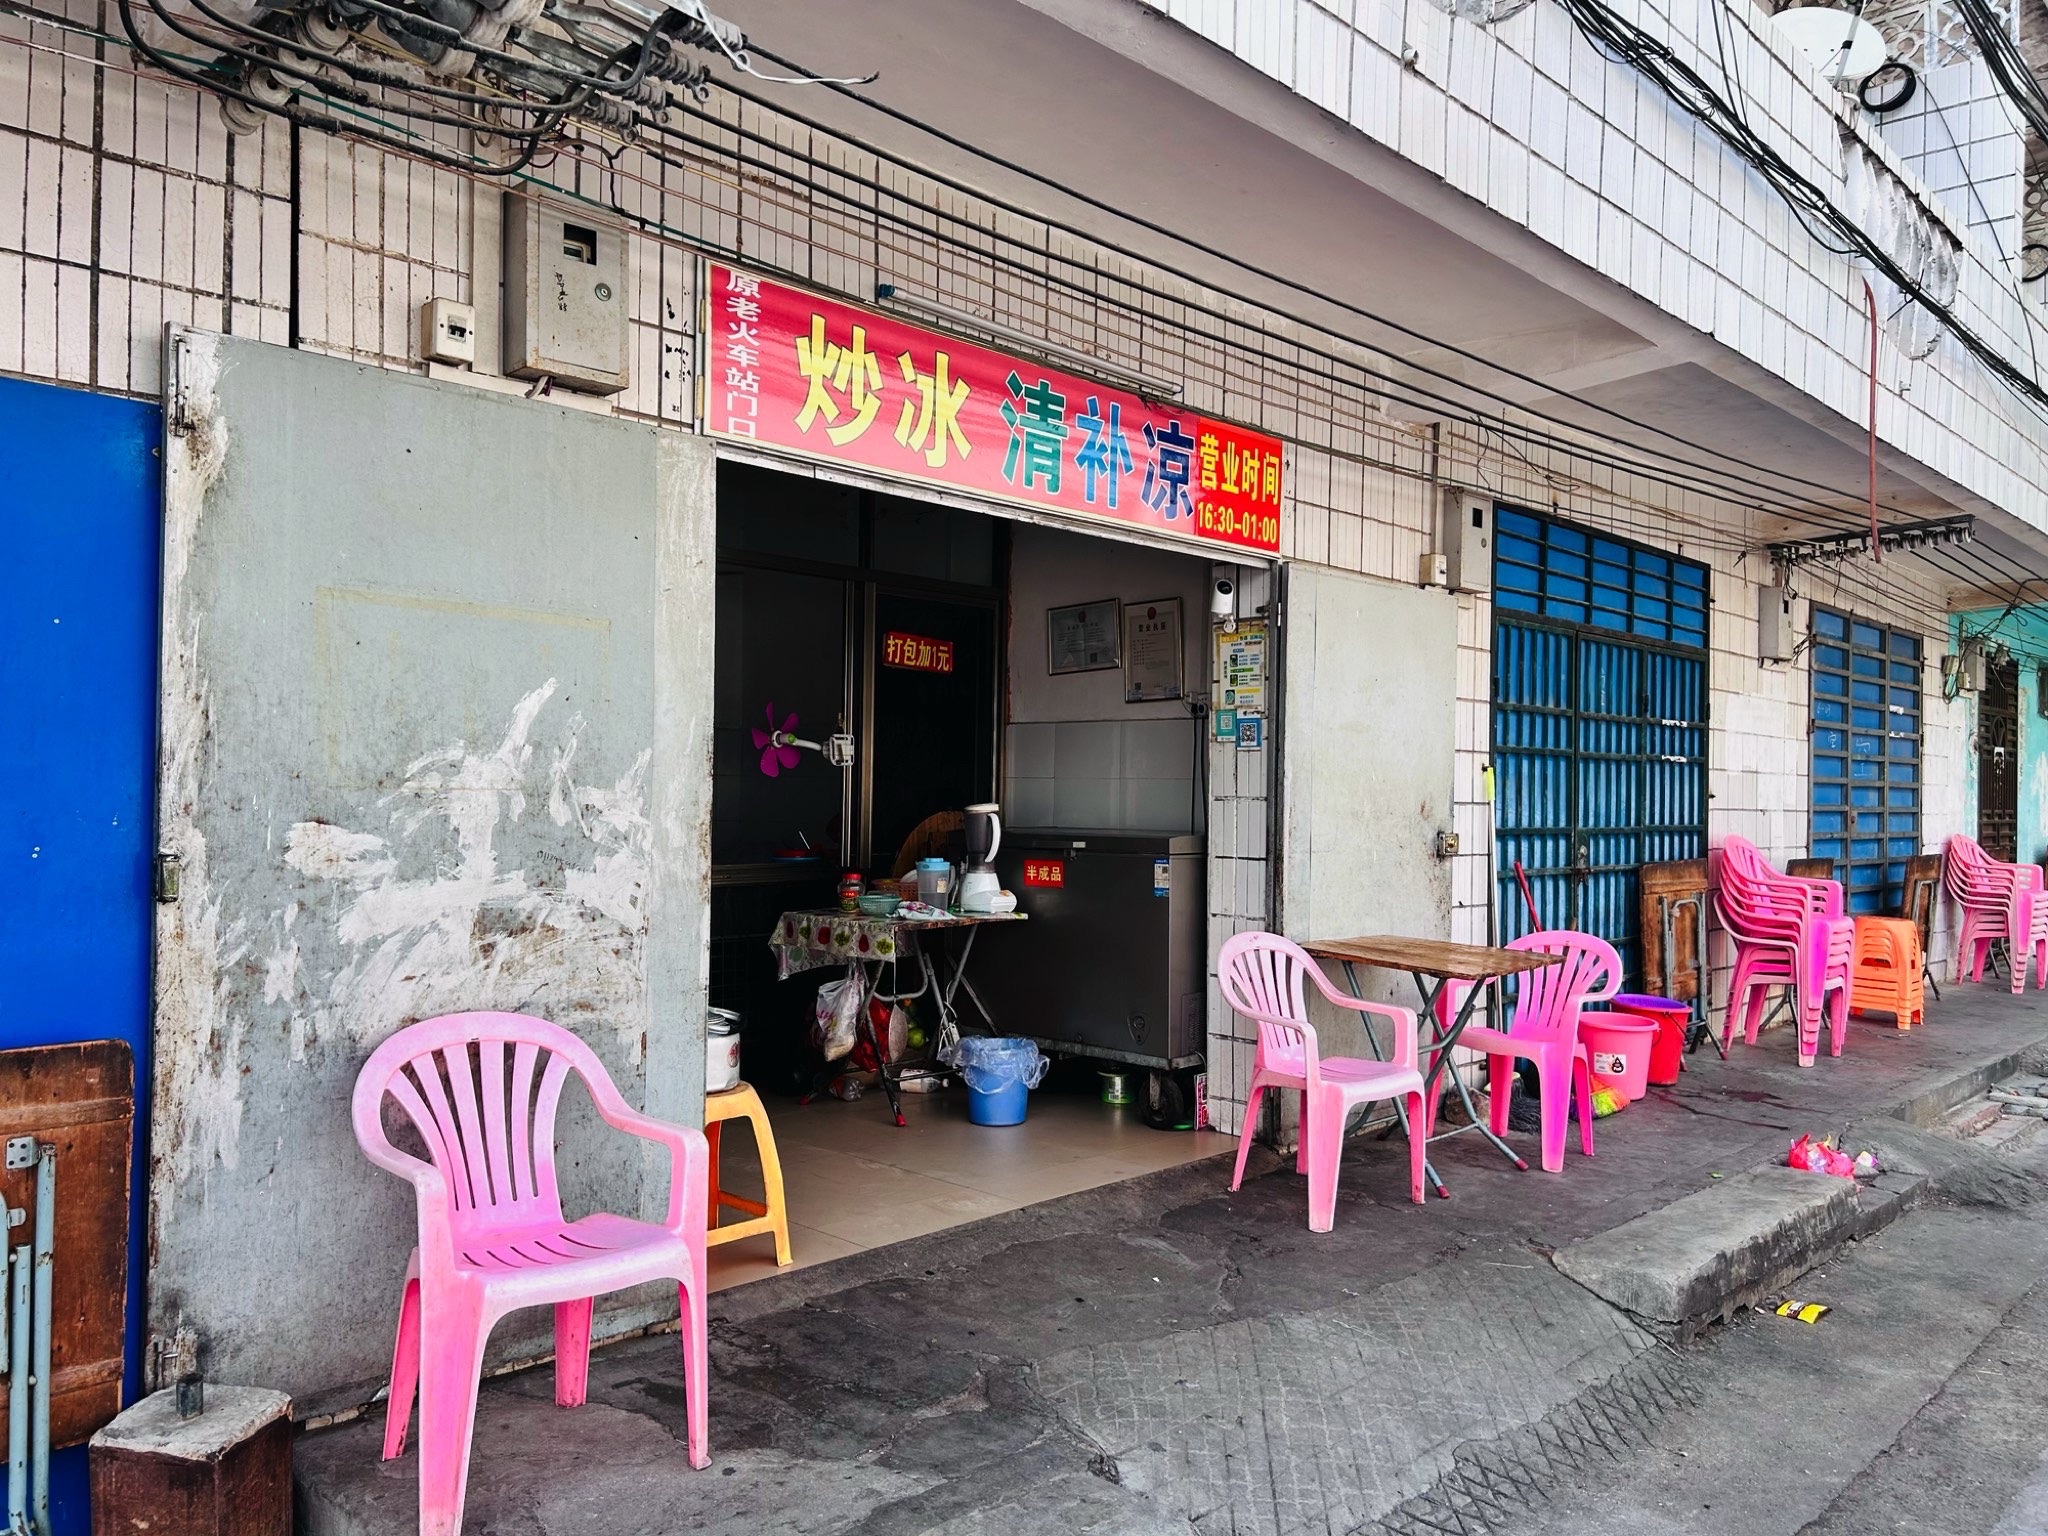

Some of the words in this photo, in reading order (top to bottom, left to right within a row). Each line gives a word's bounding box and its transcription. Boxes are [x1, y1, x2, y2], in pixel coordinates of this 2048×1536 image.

[725, 270, 761, 439] 原老火车站门口
[794, 313, 972, 468] 炒冰
[999, 370, 1196, 520] 清补凉
[1200, 433, 1279, 505] 营业时间
[1198, 501, 1277, 543] 16:30-01:00
[887, 635, 949, 671] 打包加1元
[1026, 865, 1061, 882] 半成品
